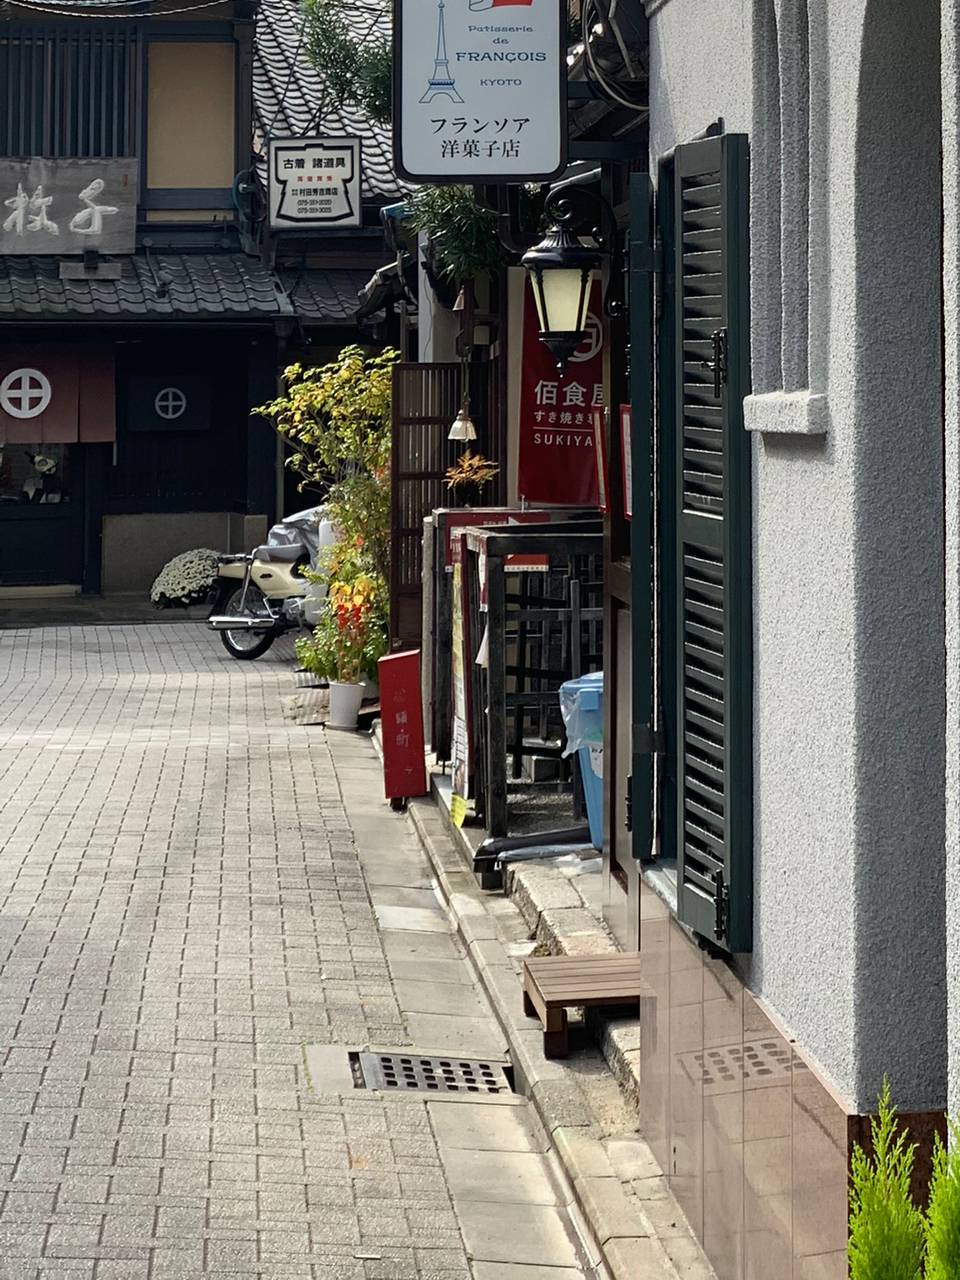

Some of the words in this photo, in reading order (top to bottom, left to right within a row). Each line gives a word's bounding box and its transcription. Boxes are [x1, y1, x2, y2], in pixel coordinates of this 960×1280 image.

[493, 37, 509, 45] de
[455, 52, 547, 63] FRANÇOIS
[430, 117, 530, 134] フランソア
[441, 140, 520, 158] 洋菓子店
